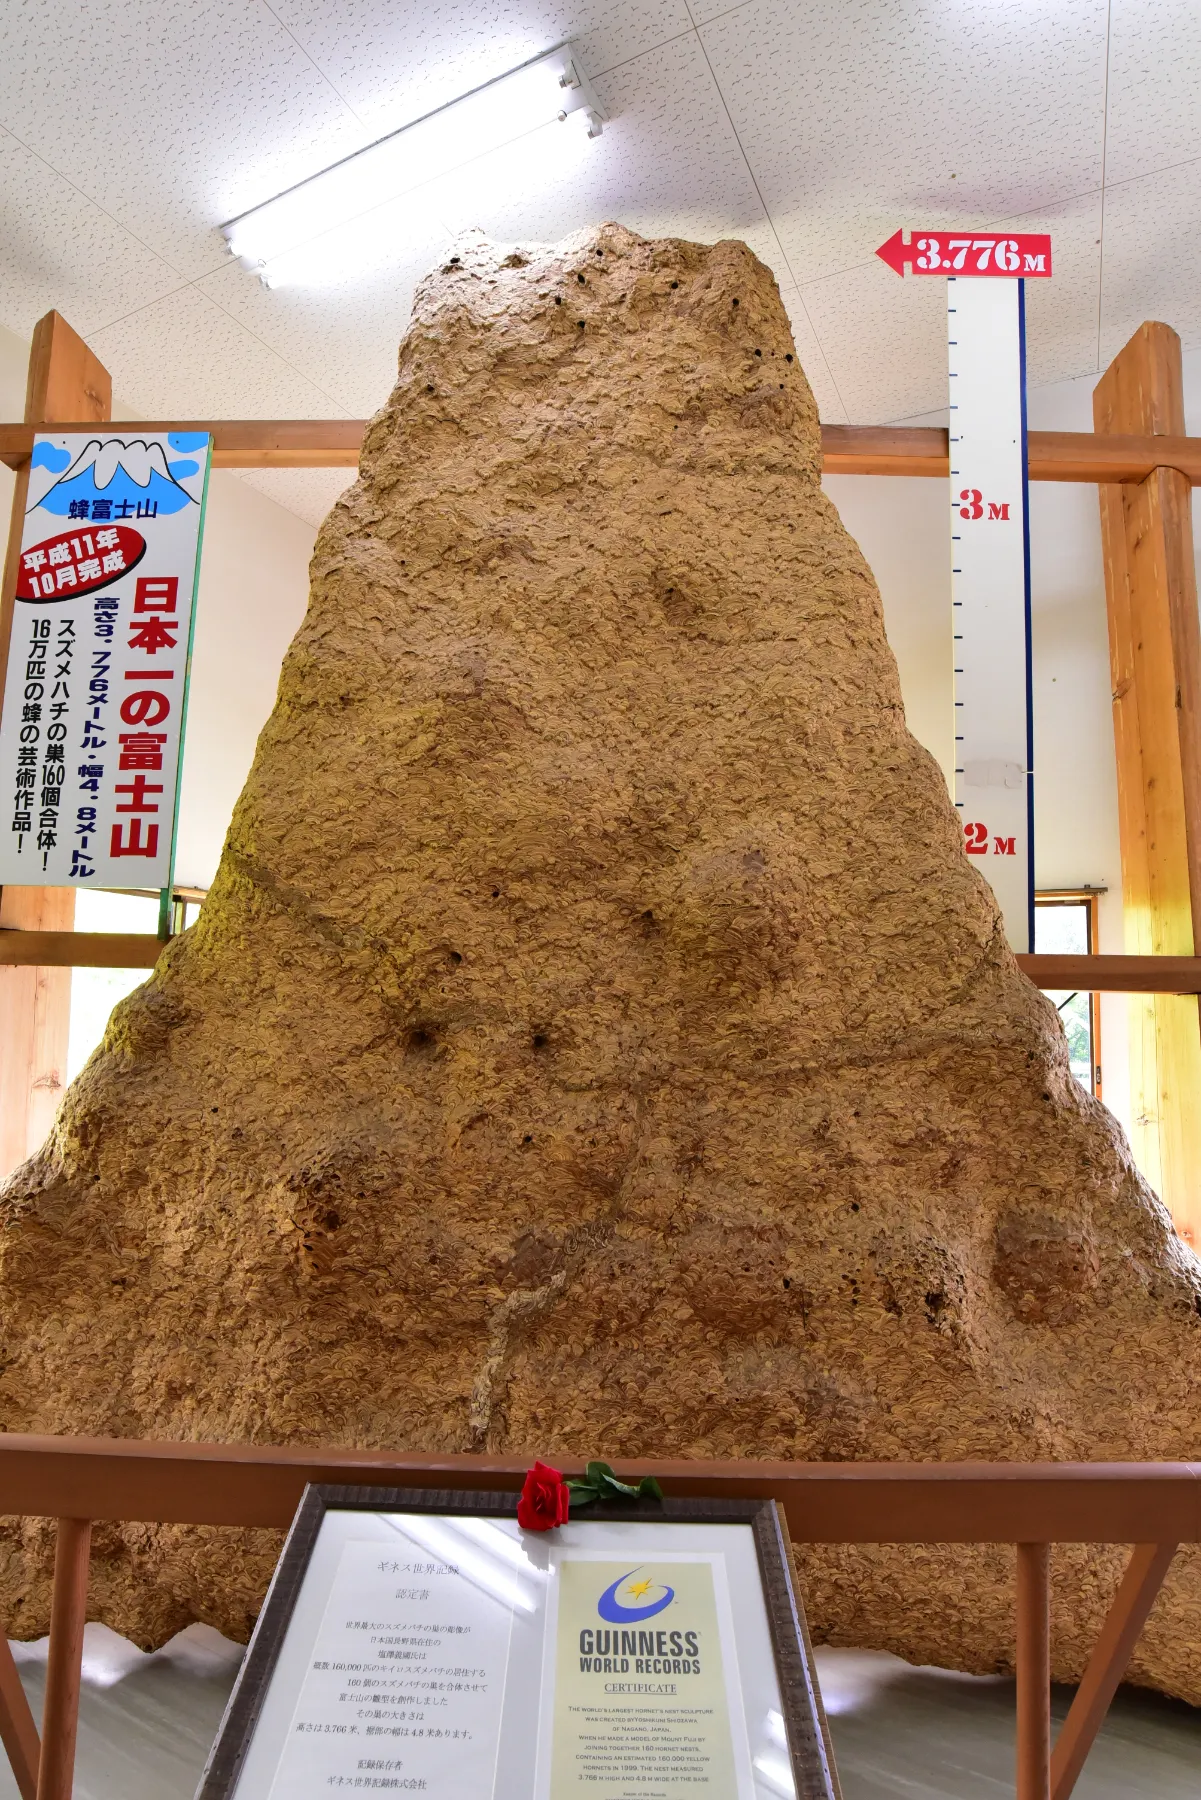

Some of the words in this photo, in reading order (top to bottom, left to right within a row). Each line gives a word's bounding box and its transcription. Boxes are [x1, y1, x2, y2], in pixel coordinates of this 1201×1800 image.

[68, 498, 158, 520] 蜂富士山
[24, 527, 120, 573] 平成11年
[29, 549, 127, 598] 10月完成
[110, 576, 179, 858] 日本一の富士山
[377, 1561, 460, 1575] ギネス世界記録
[395, 1588, 431, 1600] 認定書
[580, 1629, 699, 1657] GUINNESS
[580, 1657, 630, 1673] WORLD
[635, 1658, 701, 1675] RECORDS
[604, 1683, 677, 1693] CERTIFICATE
[357, 1759, 403, 1771] 記録保存者
